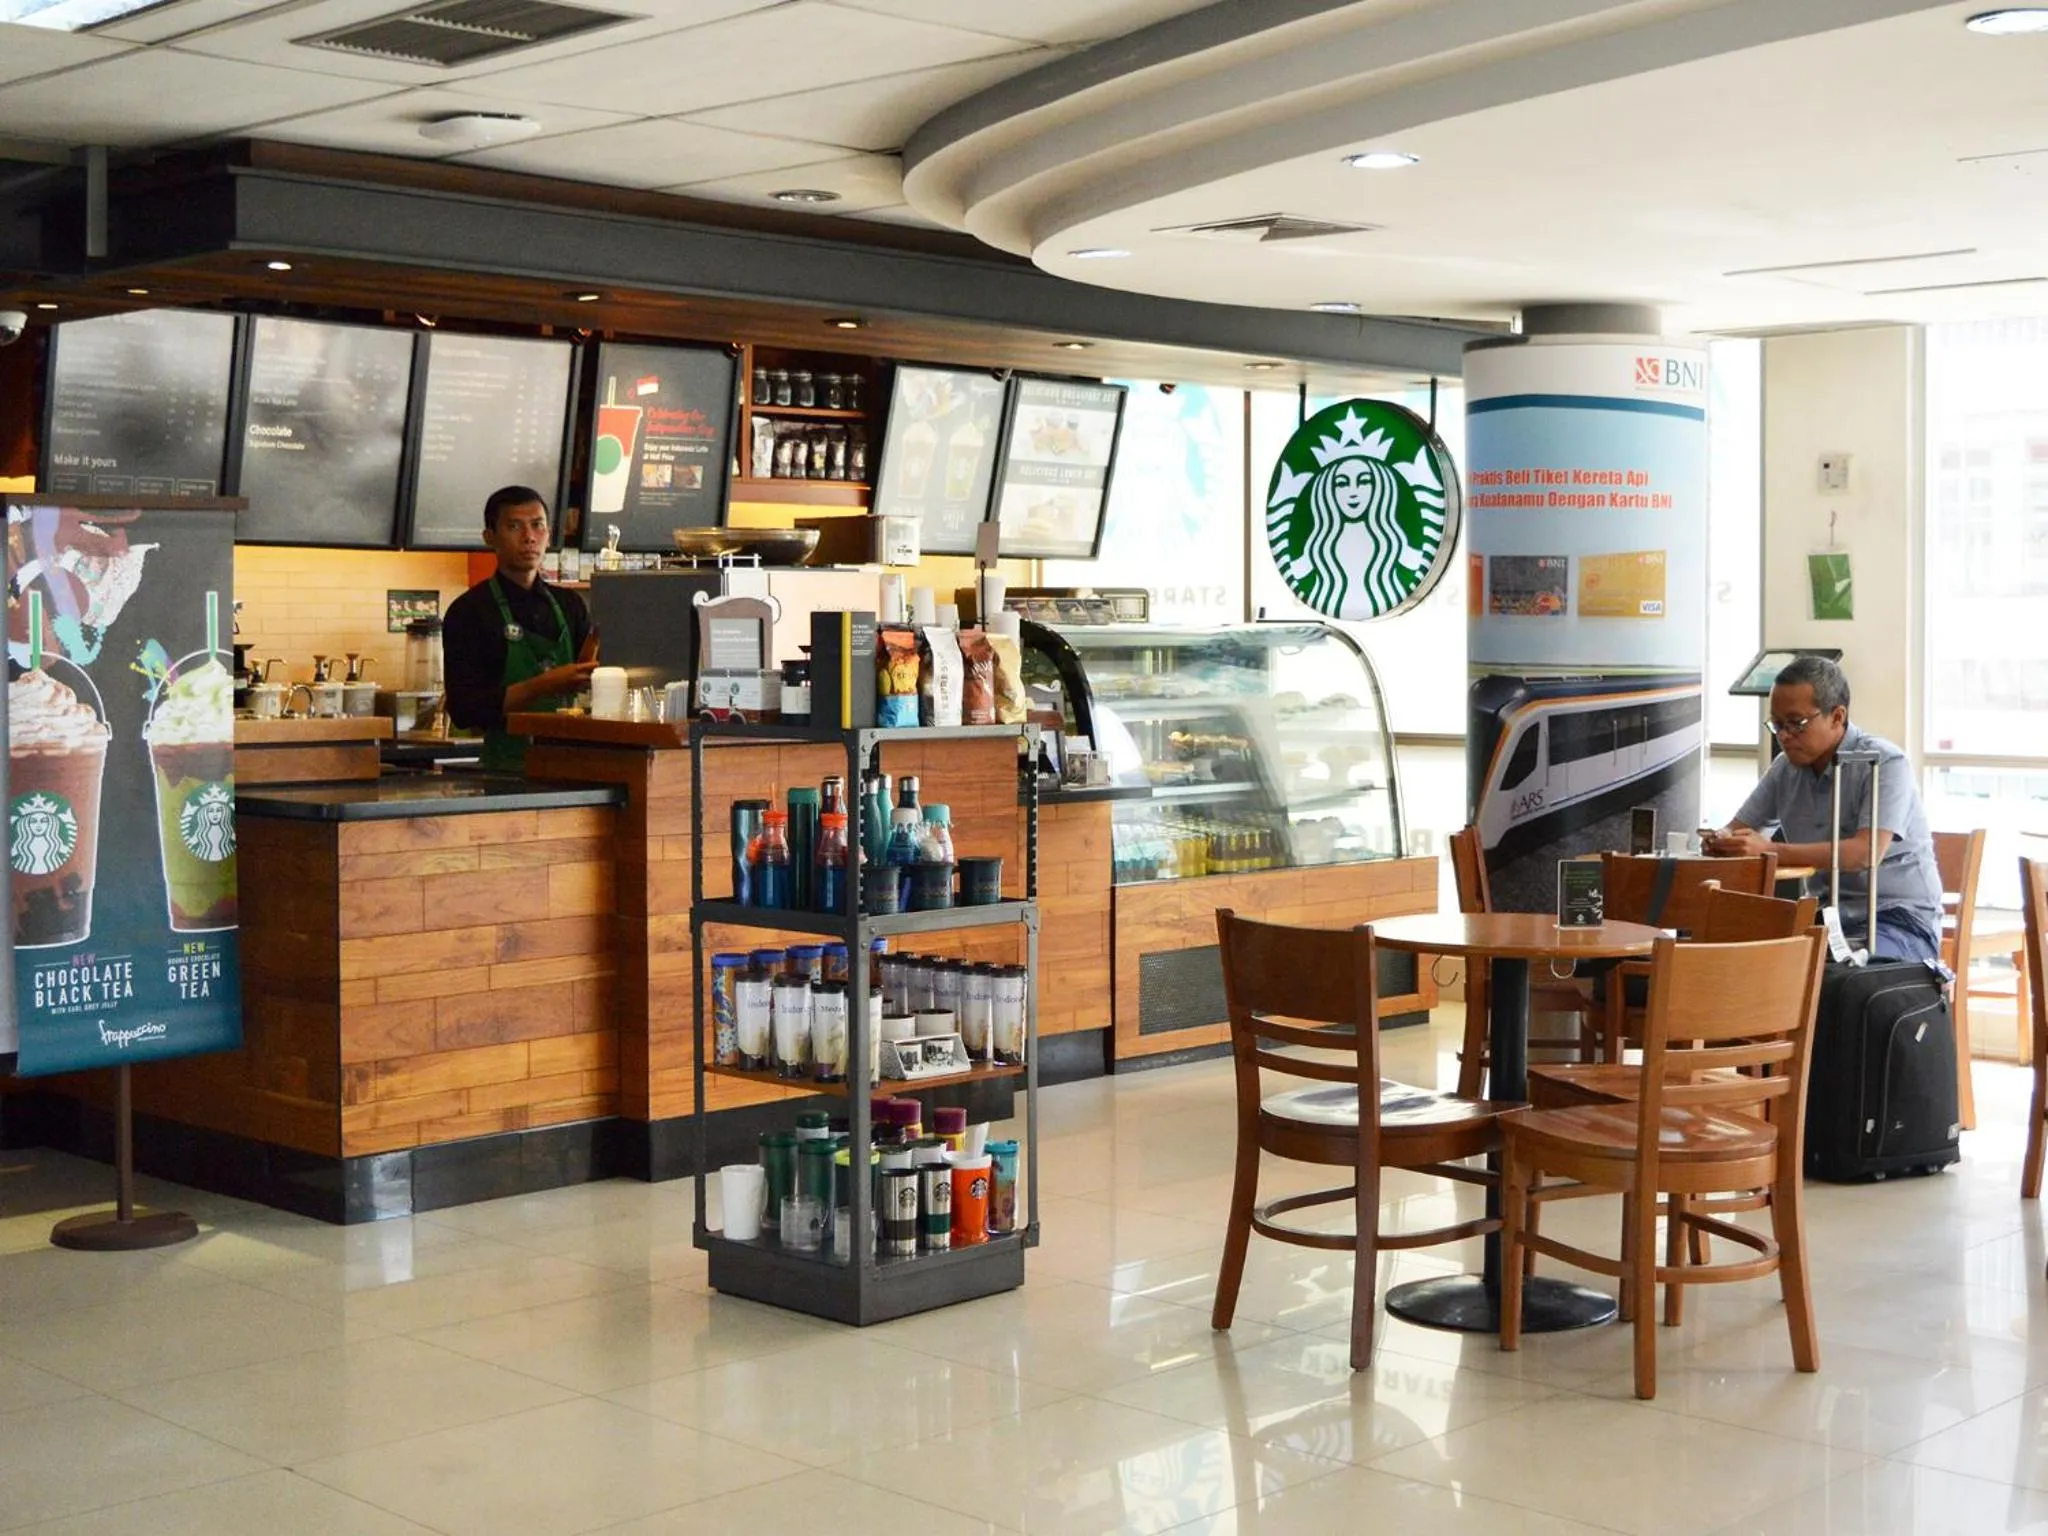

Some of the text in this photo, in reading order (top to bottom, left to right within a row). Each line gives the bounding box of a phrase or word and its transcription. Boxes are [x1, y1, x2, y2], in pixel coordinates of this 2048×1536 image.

[1665, 359, 1703, 389] BNI
[249, 424, 292, 438] Chocolate
[54, 453, 117, 469] Make it yours
[1505, 469, 1529, 485] Beli
[1533, 469, 1568, 485] Tiket
[1573, 470, 1622, 486] Kereta
[1627, 470, 1649, 487] Api
[1548, 491, 1605, 509] Dengan
[1609, 492, 1648, 508] Kartu
[1651, 494, 1672, 509] BNI
[1642, 603, 1661, 612] VISA
[184, 942, 206, 954] NEW
[72, 953, 96, 967] NEW
[34, 962, 133, 989] CHOCOLATE
[168, 961, 221, 983] GREEN
[35, 980, 134, 1008] BLACK TEA
[180, 980, 210, 999] TEA
[51, 1006, 66, 1015] WITH
